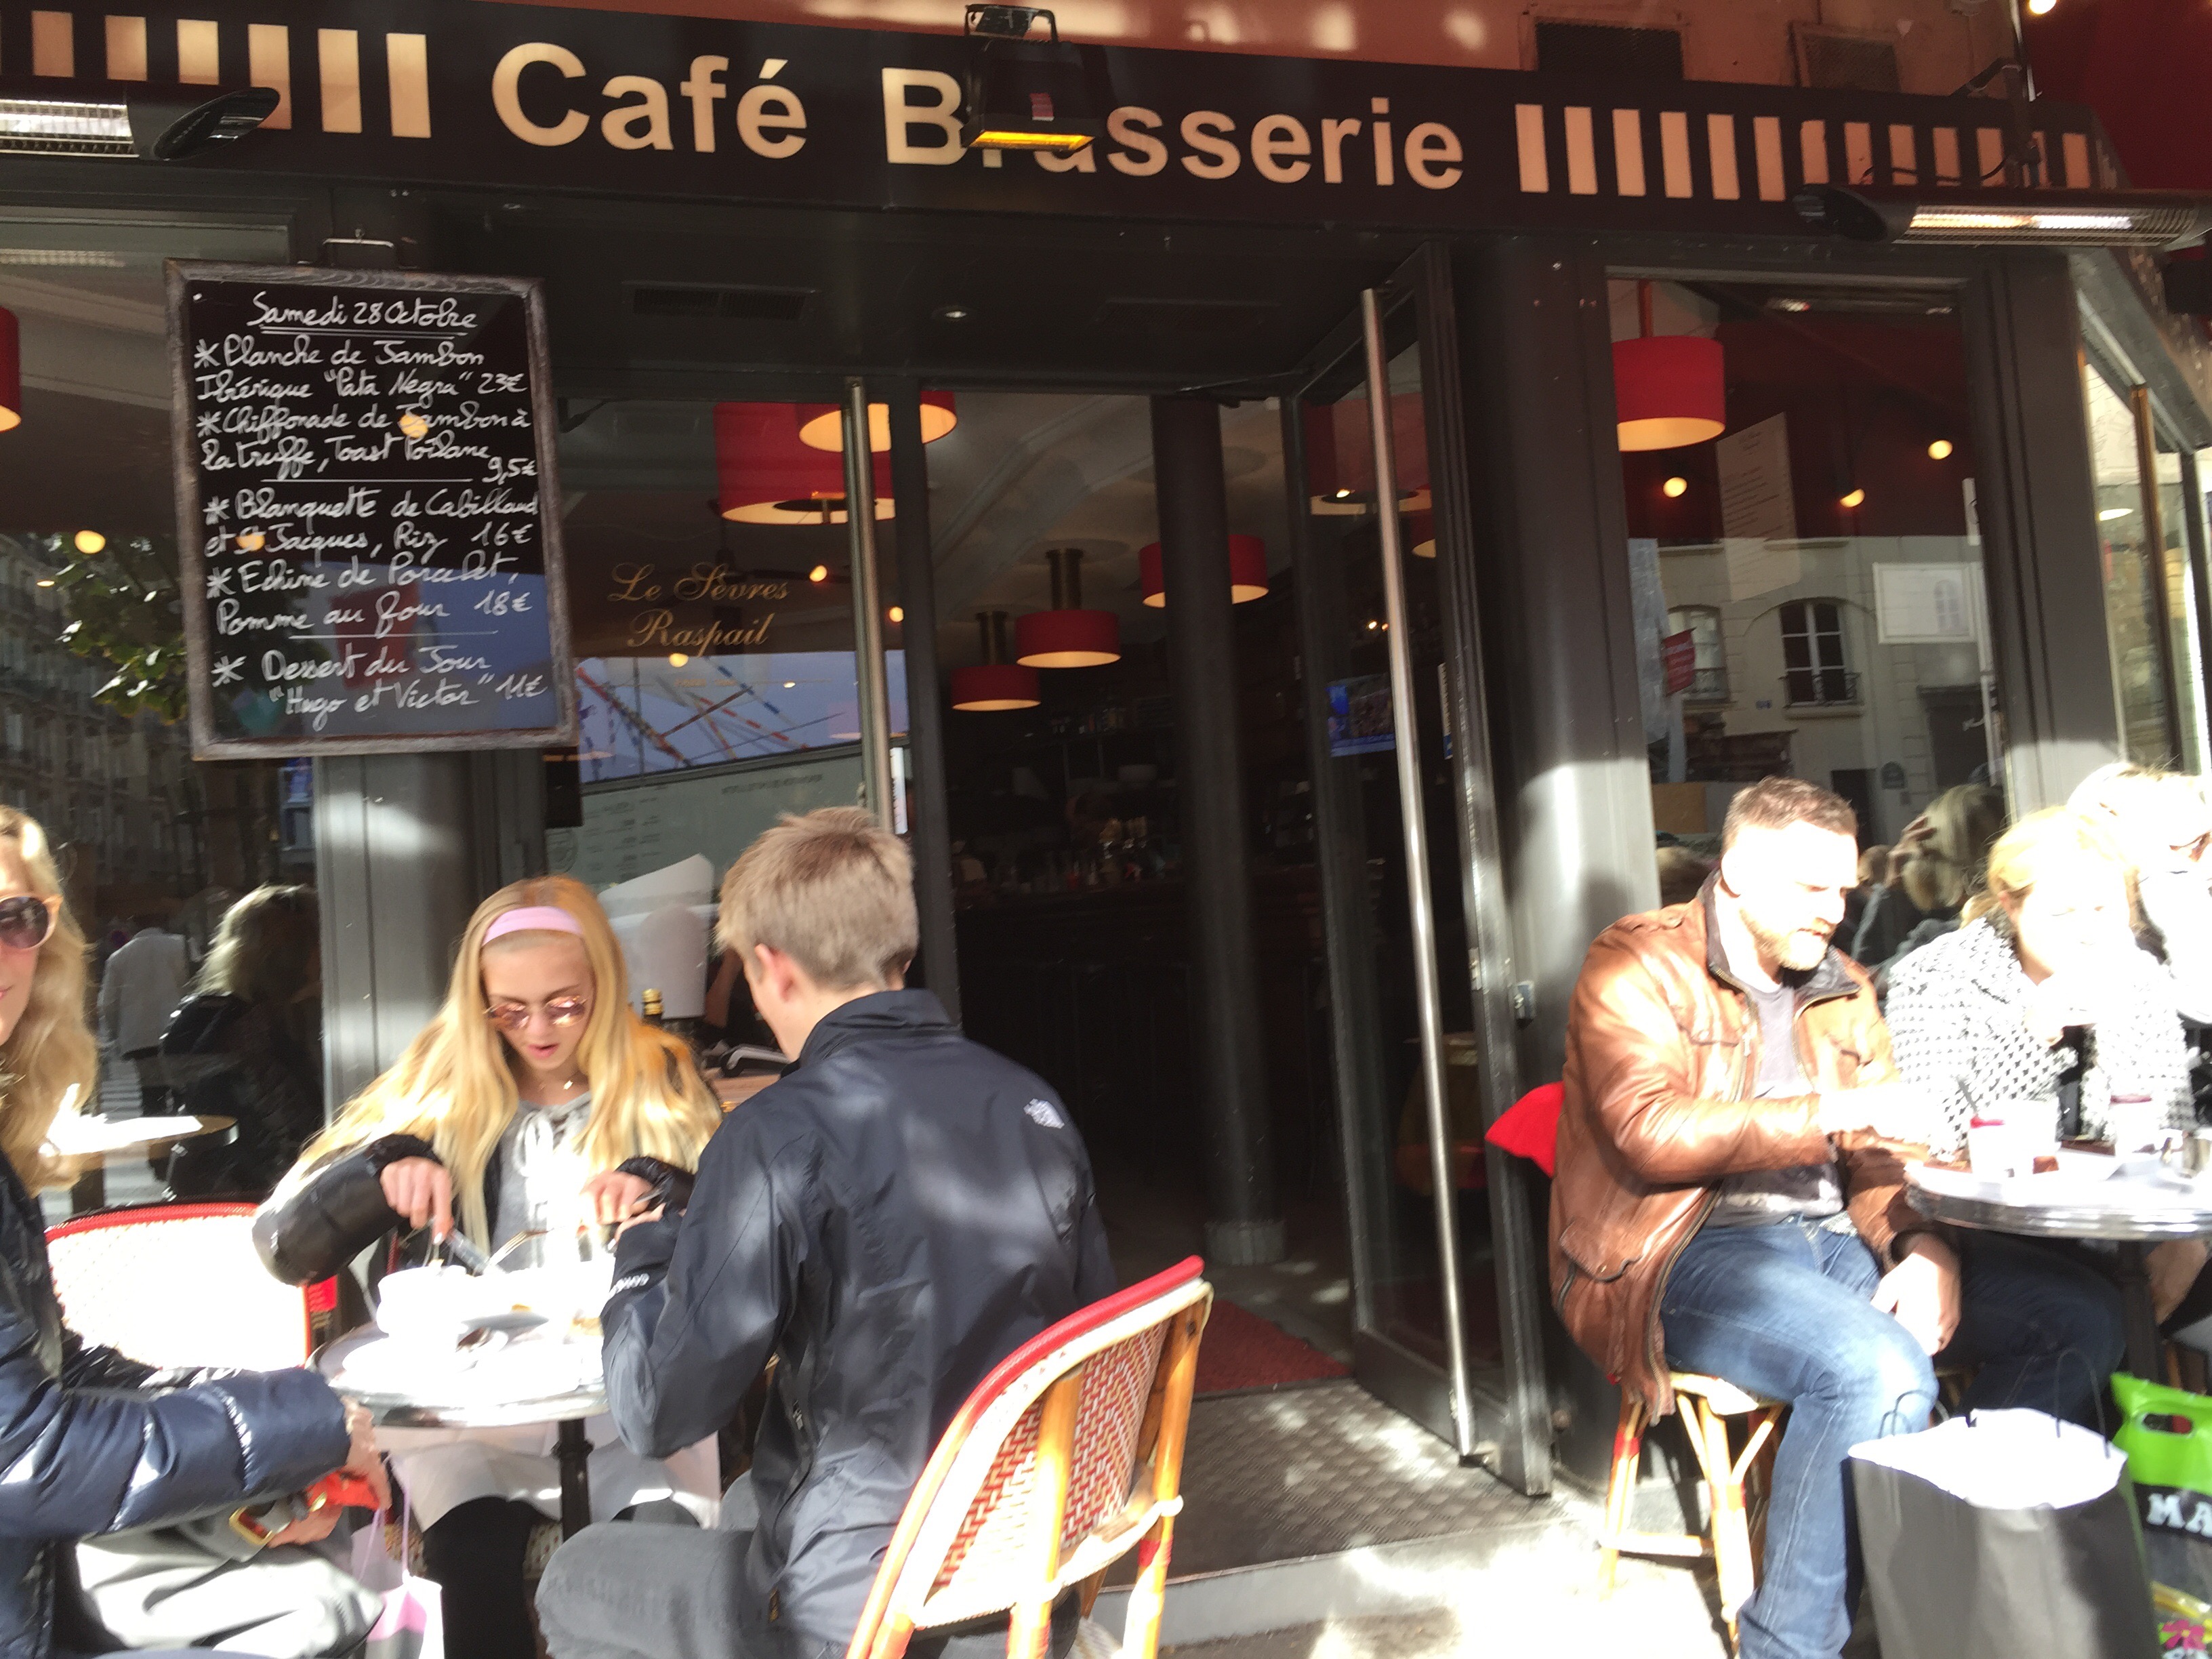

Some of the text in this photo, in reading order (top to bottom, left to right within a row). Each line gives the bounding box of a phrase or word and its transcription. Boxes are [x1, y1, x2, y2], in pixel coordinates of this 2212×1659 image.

[491, 42, 1464, 190] Café Bsserie
[246, 291, 478, 328] Samedi 28 Octobre
[224, 333, 485, 367] Planche de Jambon
[194, 369, 314, 408] Ibérique
[477, 373, 528, 394] 23€
[222, 400, 532, 445] Chiffonade de Jambon à
[201, 438, 237, 470] la
[324, 431, 405, 462] Toast
[481, 456, 539, 486] 9,5€
[234, 485, 382, 535] Blanquette
[390, 489, 423, 518] de
[204, 525, 237, 558] et
[392, 520, 449, 565] Riz
[470, 520, 534, 547] 16€
[337, 554, 377, 588] de
[607, 562, 792, 602] Le Sèvres
[216, 589, 533, 640] Pomme au four 18€
[627, 609, 775, 657] Raspail
[261, 642, 493, 682] Dessert du Jour
[354, 677, 395, 713] et
[494, 672, 549, 701] 11€
